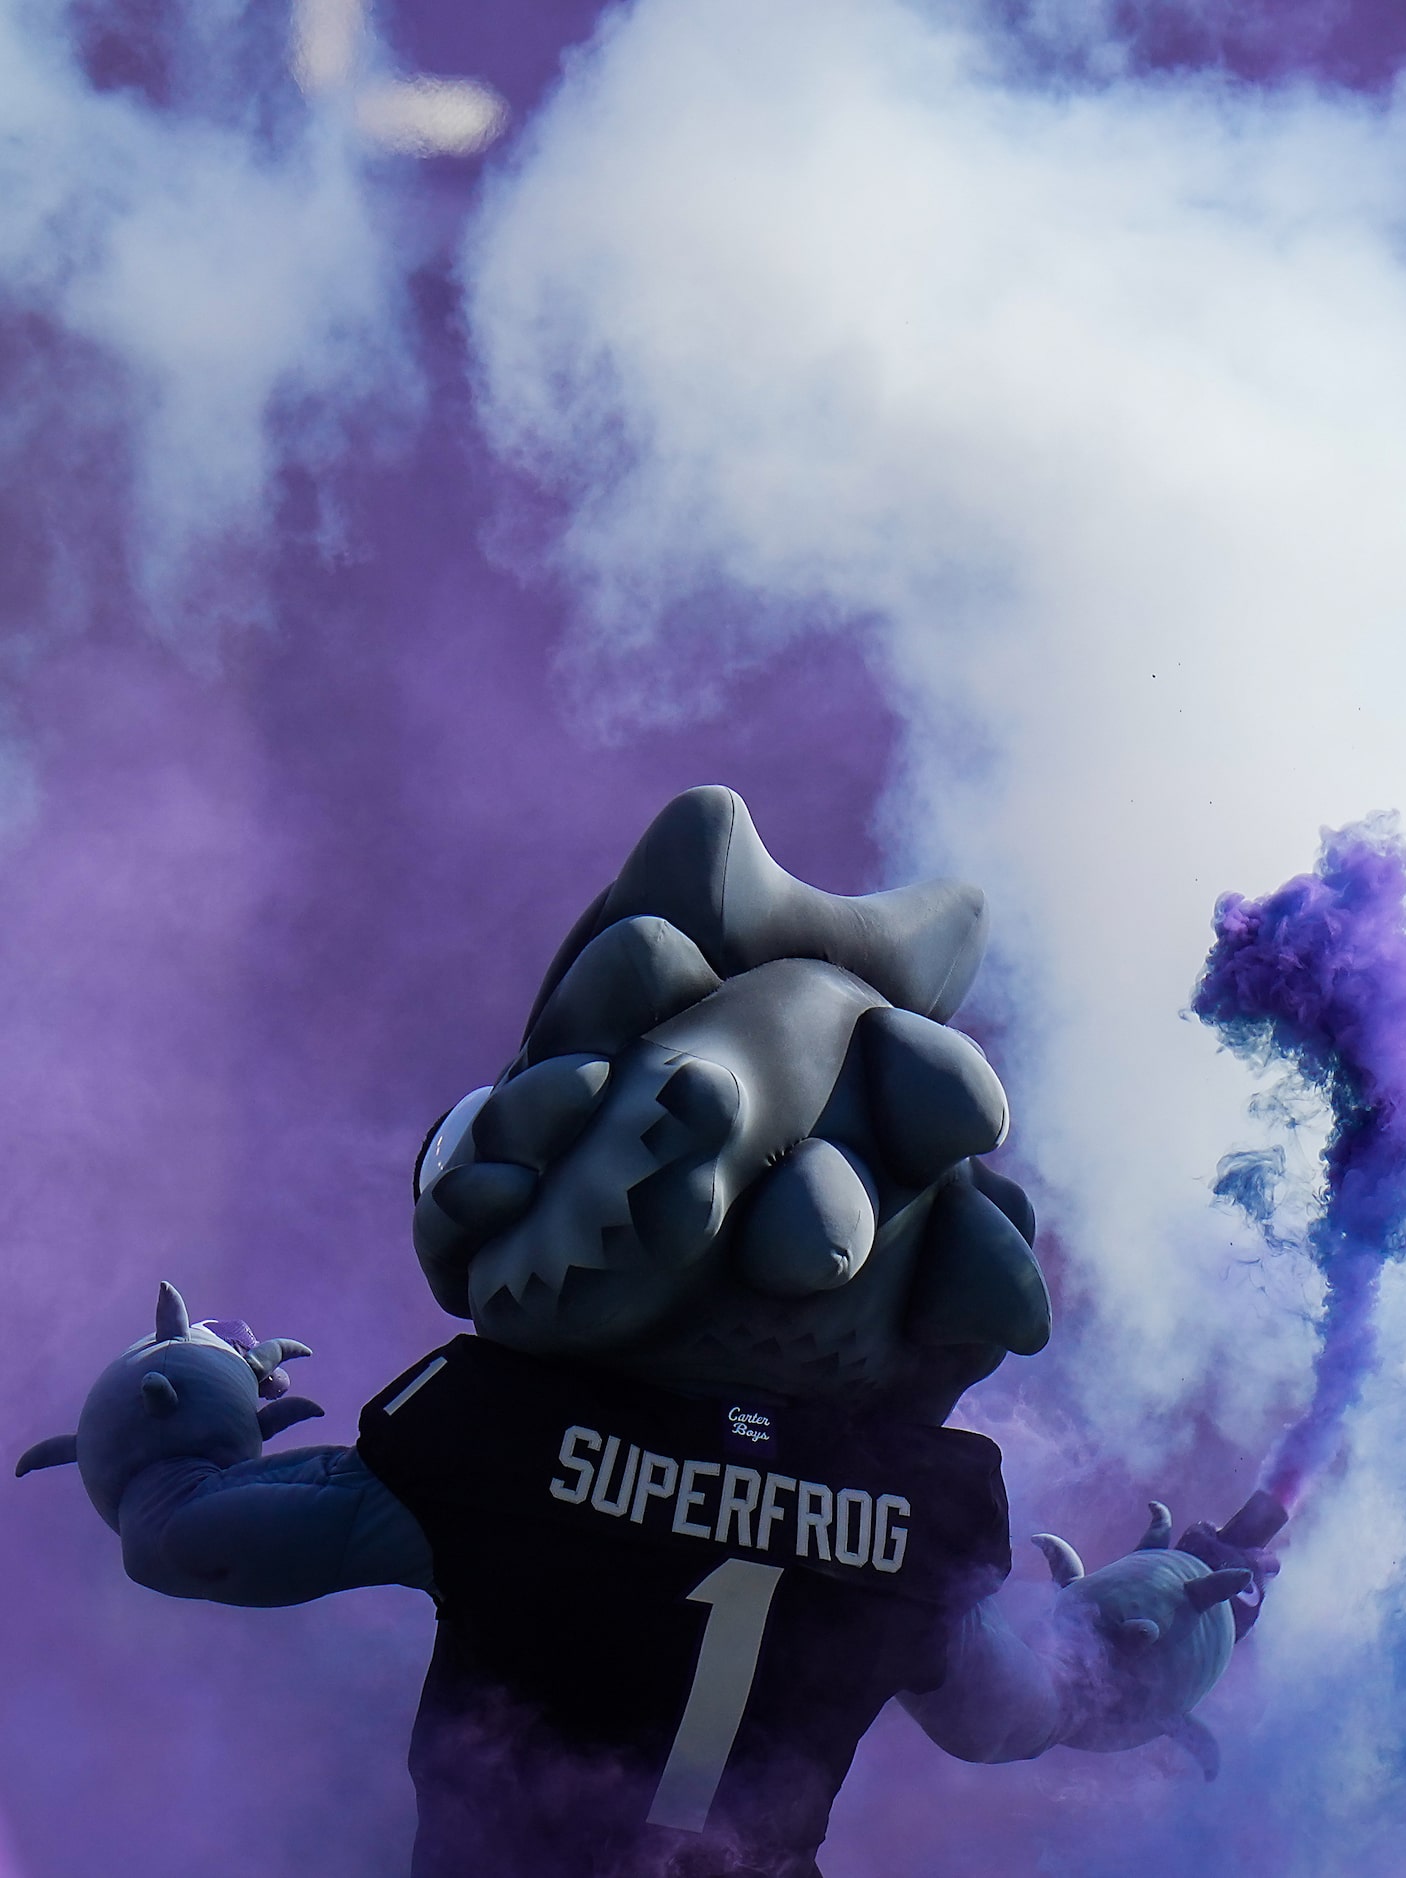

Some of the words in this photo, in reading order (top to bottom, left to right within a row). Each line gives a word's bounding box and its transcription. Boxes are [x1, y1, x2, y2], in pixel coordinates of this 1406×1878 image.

[382, 1356, 448, 1416] 1
[728, 1406, 770, 1426] Carter
[731, 1422, 770, 1442] Boys
[549, 1425, 910, 1574] SUPERFROG
[646, 1558, 784, 1835] 1
